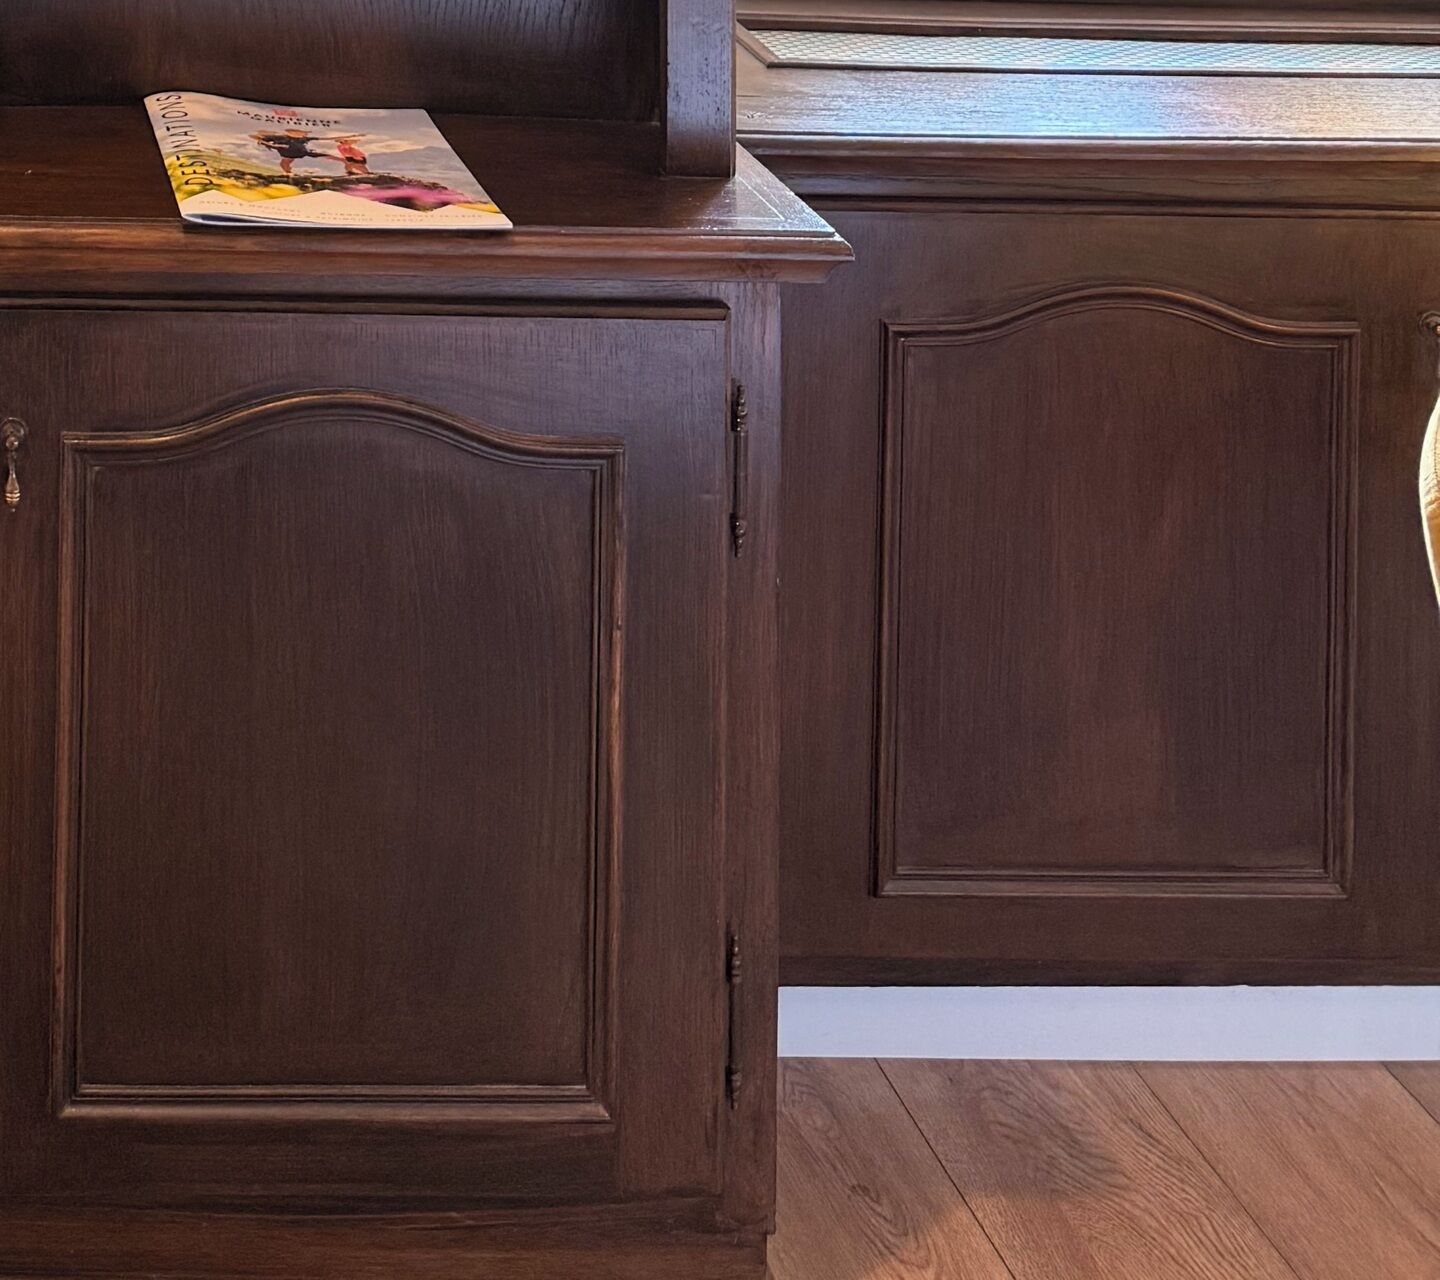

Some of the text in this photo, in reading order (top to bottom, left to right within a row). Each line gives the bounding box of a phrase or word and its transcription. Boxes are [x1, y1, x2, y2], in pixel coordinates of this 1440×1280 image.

[236, 109, 341, 124] MAURIENNE
[250, 116, 331, 128] GALIBIER
[156, 94, 213, 186] DESTINATIONS
